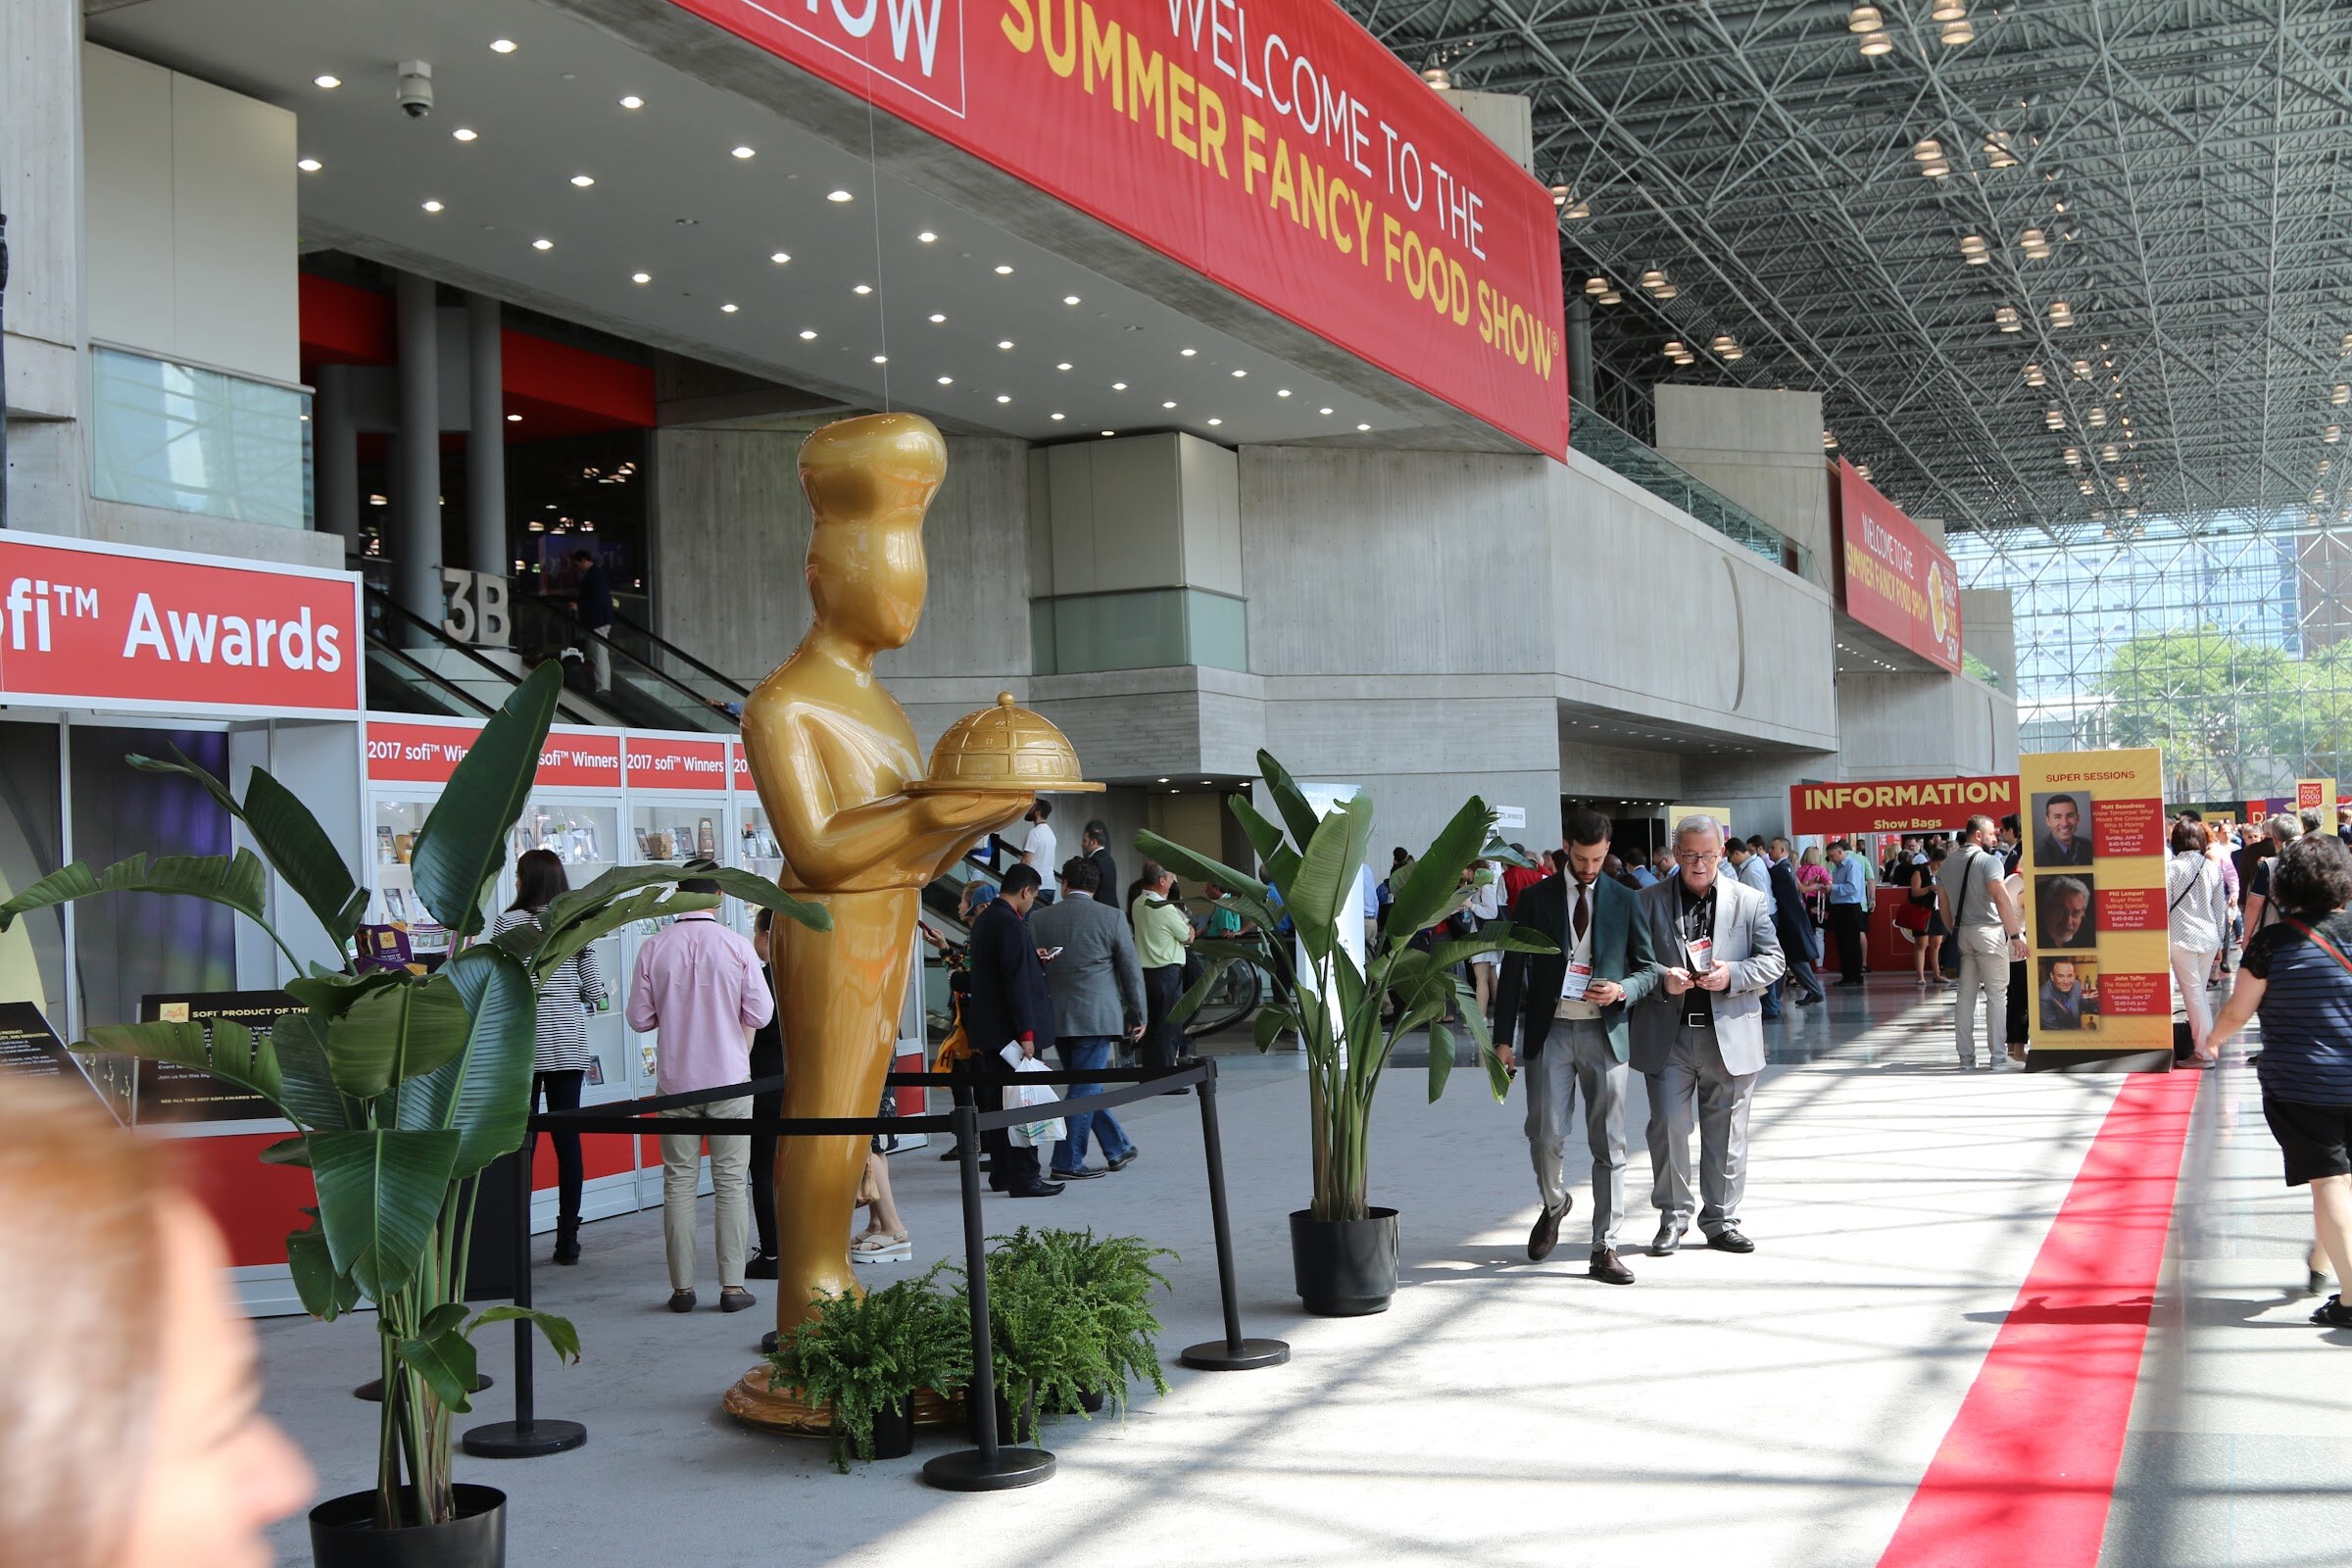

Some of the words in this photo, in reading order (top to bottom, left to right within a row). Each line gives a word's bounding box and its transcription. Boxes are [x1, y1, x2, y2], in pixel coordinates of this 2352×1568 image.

[1167, 0, 1372, 178] WELCOME
[1380, 121, 1423, 212] TO
[1431, 162, 1486, 262] THE
[1000, 0, 1230, 180] SUMMER
[1241, 114, 1373, 267] FANCY
[1383, 212, 1470, 326] FOOD
[1862, 512, 1893, 565] WELCOME
[1846, 540, 1875, 590] SUMMER
[1874, 560, 1895, 603] FANCY
[1896, 575, 1911, 613] FOOD
[443, 567, 512, 648] 3B
[122, 592, 341, 673] Awards
[368, 740, 401, 760] 2017
[572, 751, 618, 768] Winners
[627, 754, 652, 770] 2017
[683, 756, 724, 773] Winners
[2046, 773, 2081, 783] SUPER
[2083, 770, 2135, 781] SESSIONS
[1805, 781, 2010, 810] INFORMATION
[1874, 818, 1908, 830] Show
[1911, 818, 1942, 830] Bags
[221, 1008, 272, 1017] PRODUCT
